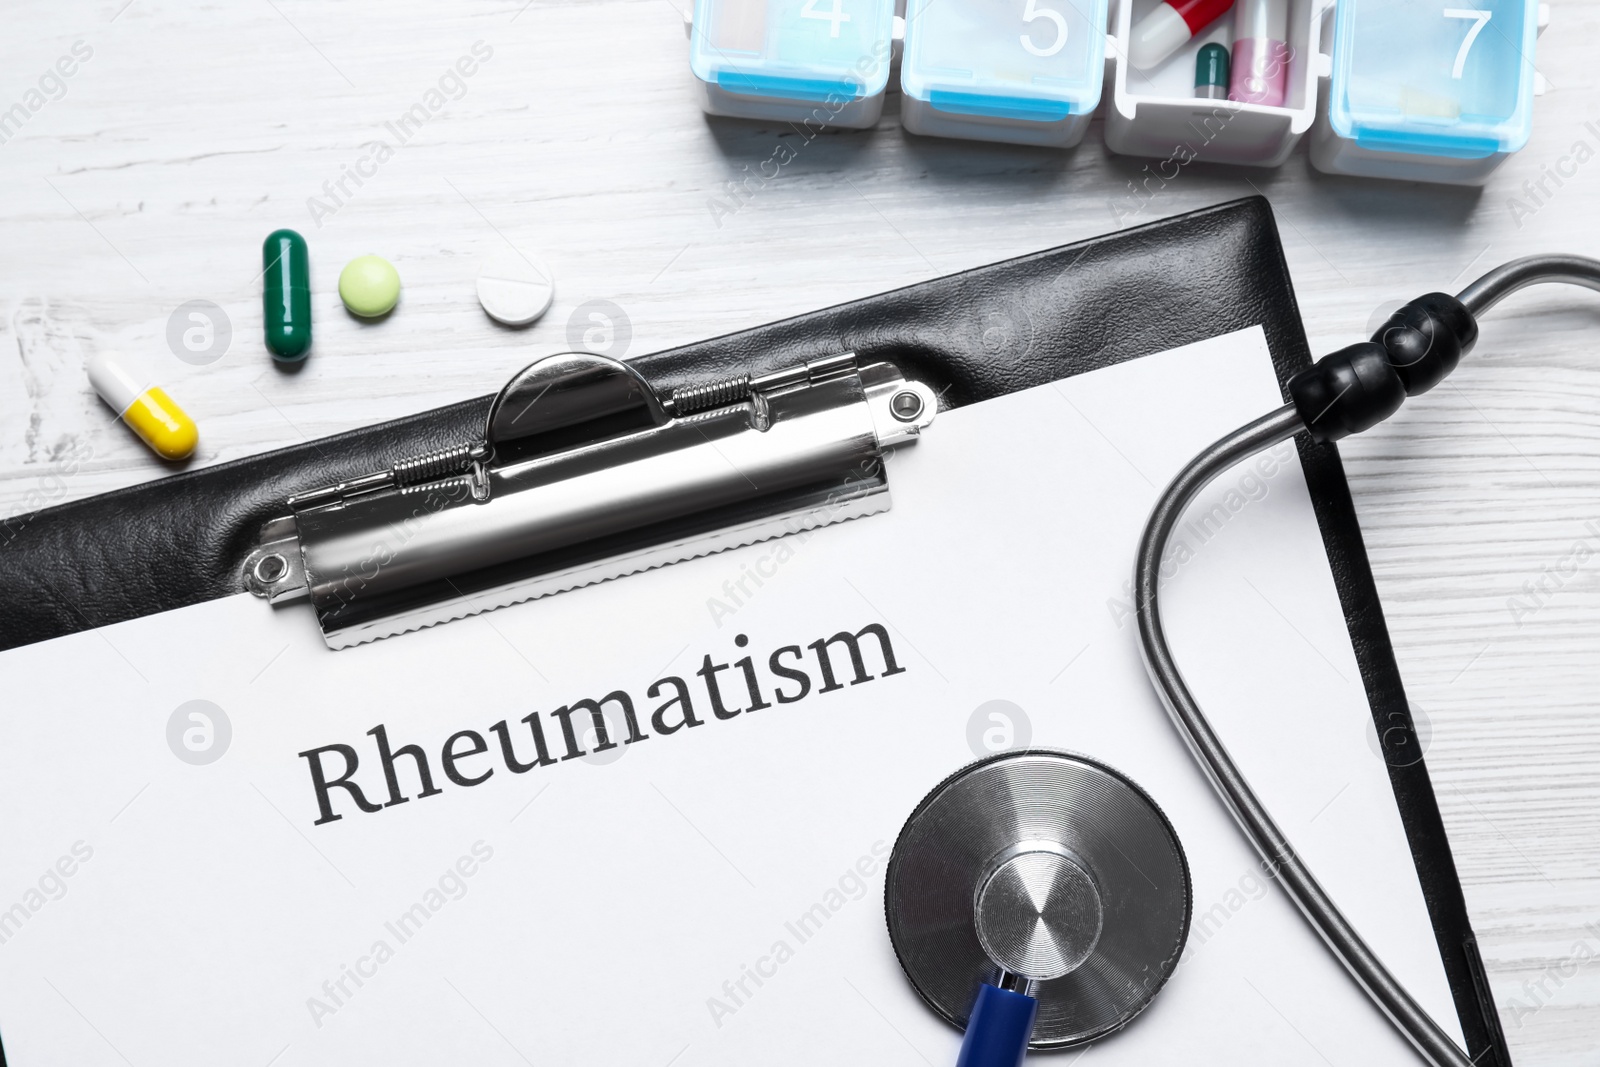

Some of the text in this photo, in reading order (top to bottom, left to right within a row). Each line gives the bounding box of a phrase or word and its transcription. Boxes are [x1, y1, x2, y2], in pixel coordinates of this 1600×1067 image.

[1019, 0, 1069, 57] 5
[1443, 8, 1492, 80] 7
[298, 622, 906, 826] Rheumatism
